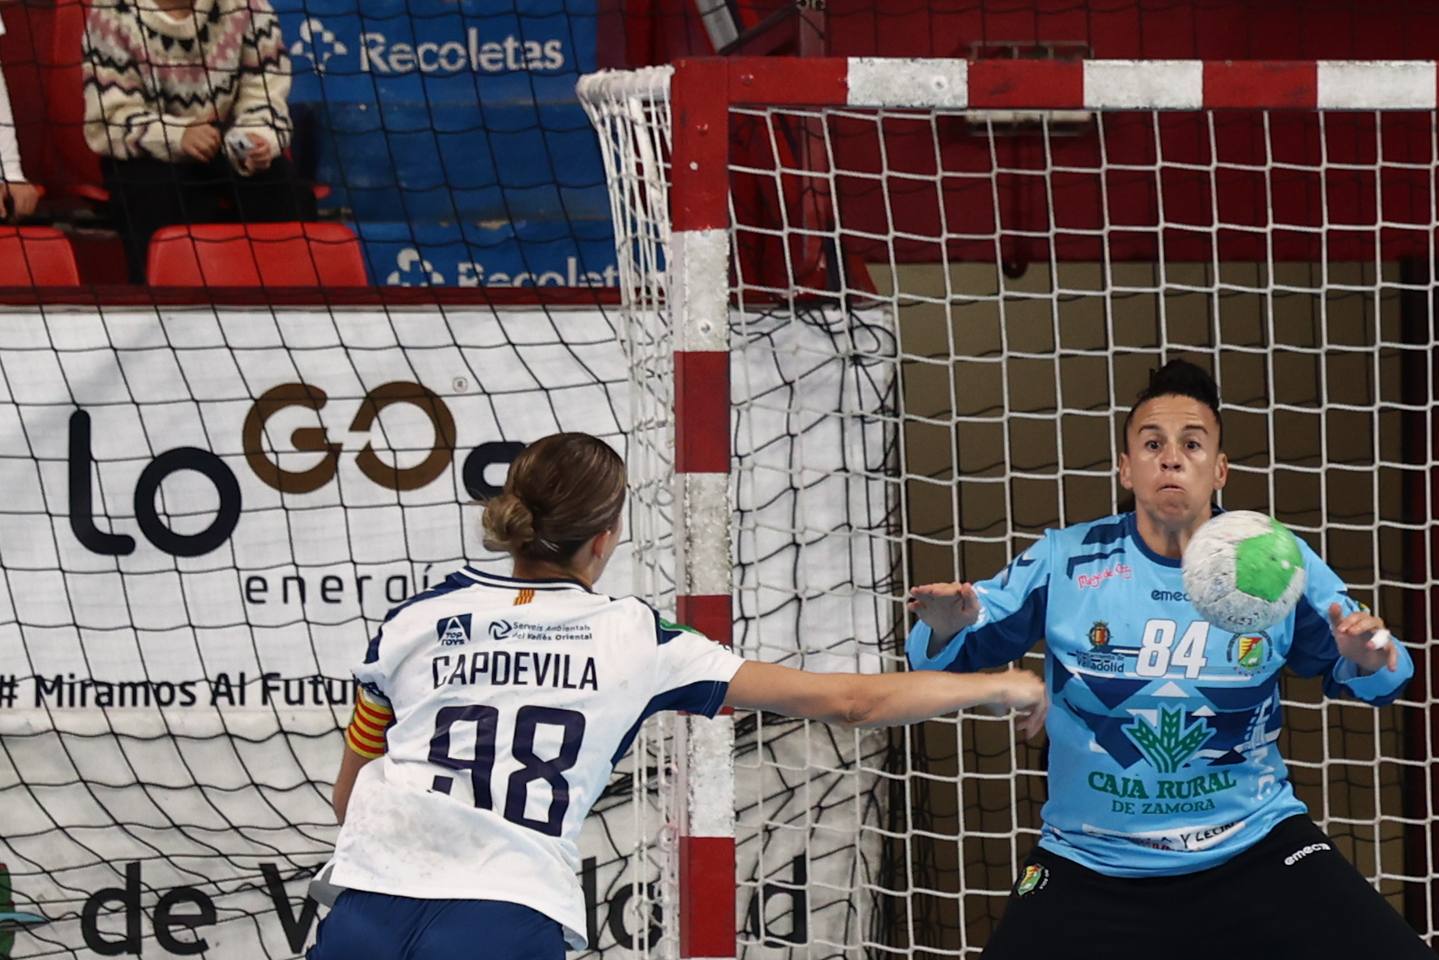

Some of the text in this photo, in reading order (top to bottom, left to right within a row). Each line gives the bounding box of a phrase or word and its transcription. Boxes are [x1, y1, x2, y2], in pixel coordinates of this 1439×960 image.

[359, 28, 564, 73] Recoletas
[245, 562, 433, 604] energí
[555, 632, 593, 641] Oriental
[1136, 619, 1211, 679] 84
[34, 674, 196, 708] Miramos
[432, 651, 599, 691] CAPDEVILA
[428, 705, 586, 837] 98
[1088, 770, 1237, 800] CAJA RURAL
[1112, 799, 1216, 815] DE ZAMORA
[81, 861, 217, 956] de
